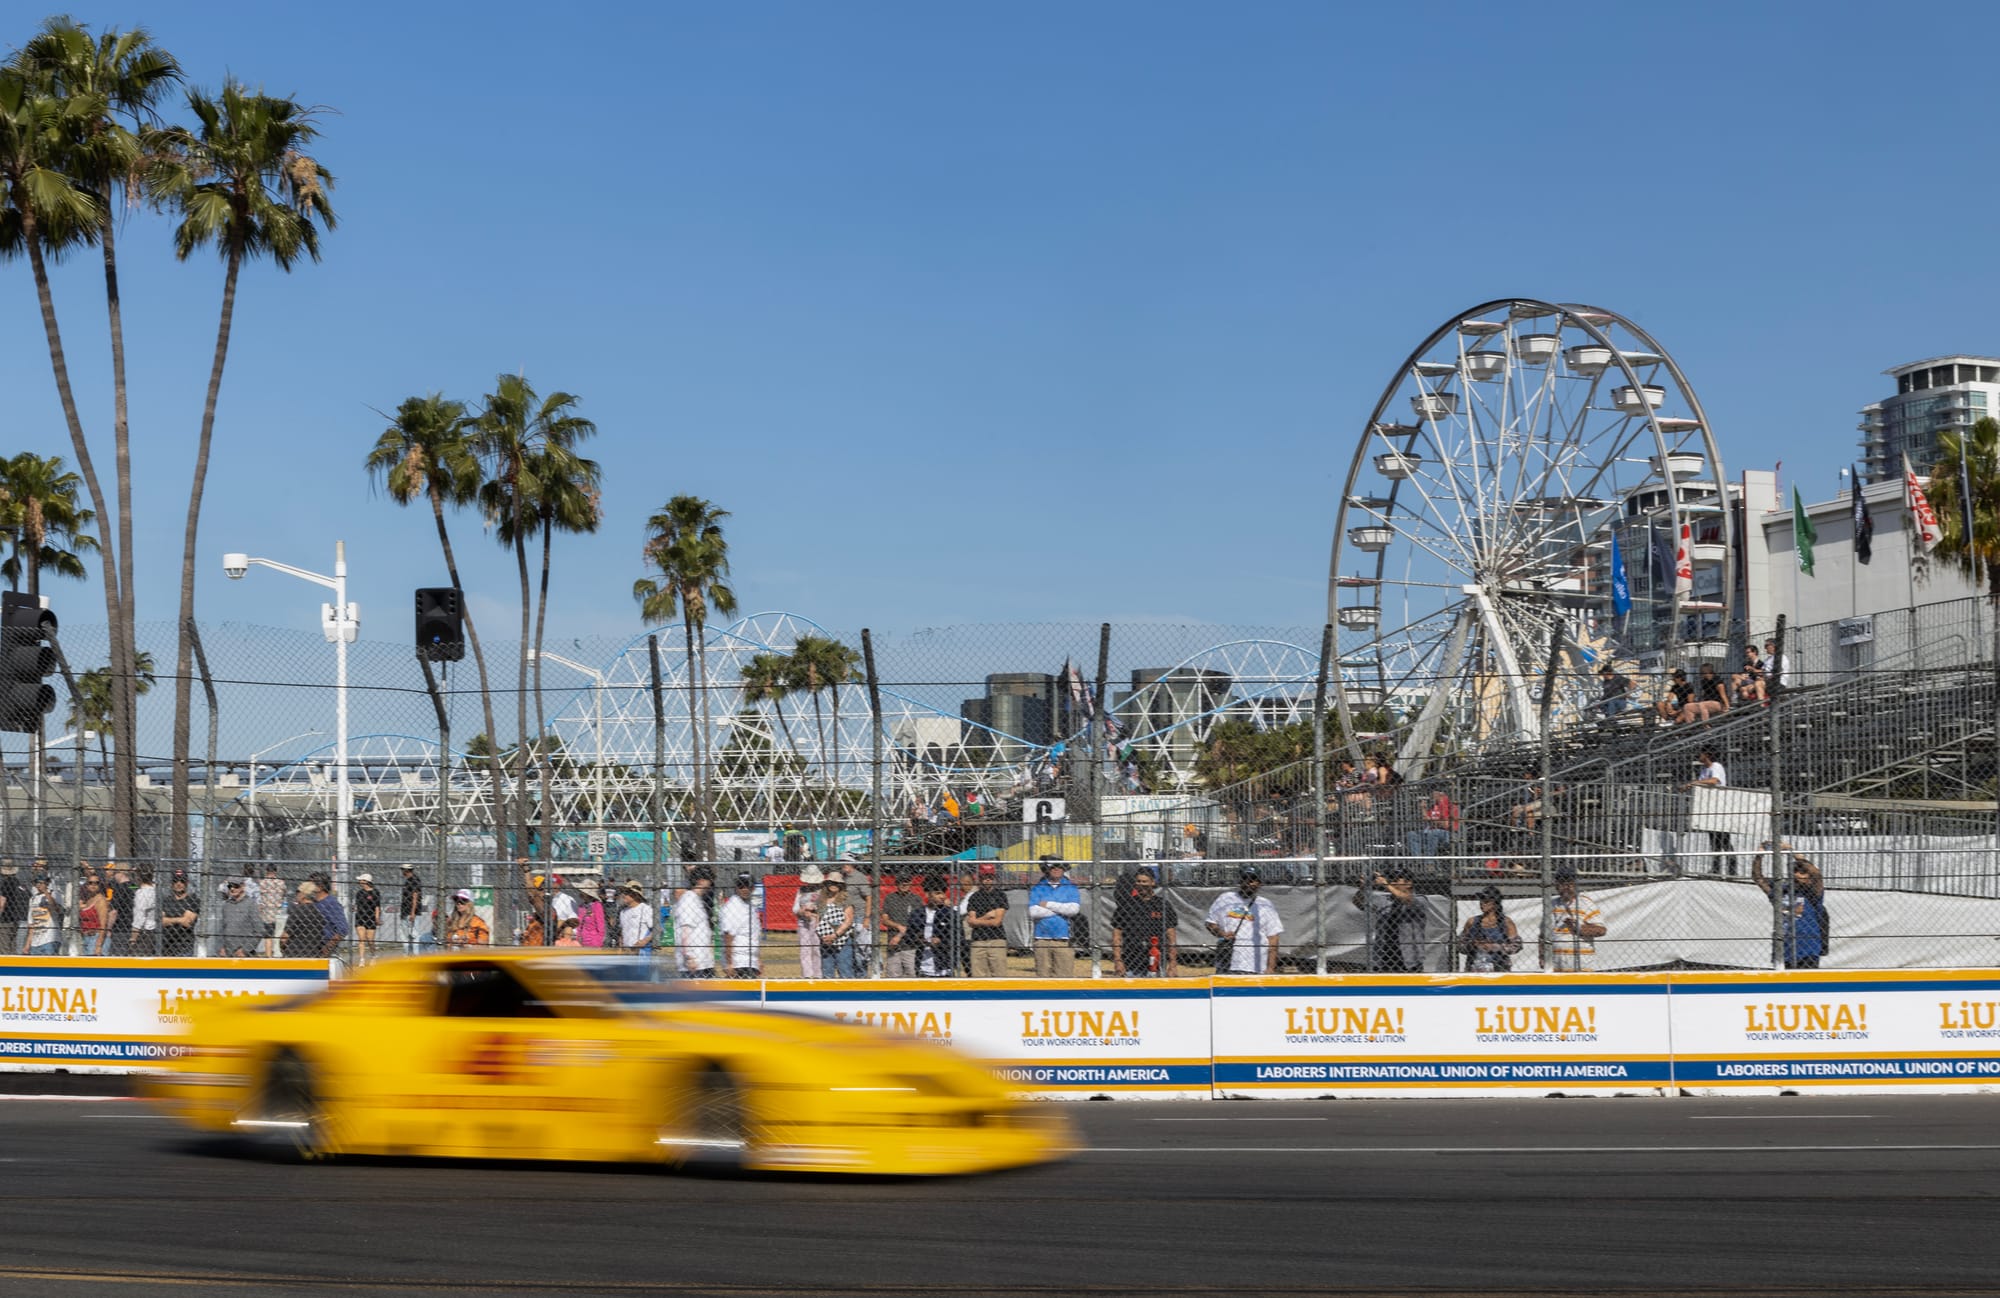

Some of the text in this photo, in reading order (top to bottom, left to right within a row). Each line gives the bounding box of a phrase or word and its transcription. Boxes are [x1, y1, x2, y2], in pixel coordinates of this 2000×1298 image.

[591, 843, 605, 853] 35
[2, 986, 97, 1014] LiUNA!
[2, 1012, 98, 1022] YOUR WORKFORCE SOLUTION
[158, 1016, 179, 1024] YOUR
[1285, 1007, 1404, 1034] LiUNA!
[1475, 1005, 1596, 1033] LiUNA!
[1744, 1003, 1866, 1031] LiUNA!
[1939, 1001, 2000, 1029] LiU
[1021, 1010, 1139, 1037] LiUNA!
[1286, 1035, 1406, 1043] YOUR WORKFORCE SOLUTION
[1502, 1034, 1553, 1042] WORKFORCE
[1556, 1034, 1597, 1042] SOLUTION
[1771, 1032, 1824, 1040] WORKFORCE
[1940, 1030, 1964, 1038] YOUR
[1100, 1038, 1140, 1046] SOLUTION
[34, 1043, 124, 1056] INTERNATIONAL
[126, 1045, 166, 1056] UNION
[169, 1046, 186, 1057] OF
[1035, 1069, 1055, 1081] OF
[1057, 1069, 1105, 1081] NORTH
[1107, 1069, 1170, 1080] AMERICA
[1256, 1066, 1628, 1078] LABORERS INTERNATIONAL UNION OF NORTH AMERICA
[1717, 1064, 1788, 1076] LABORERS
[1791, 1063, 1903, 1076] INTERNATIONAL
[1905, 1062, 1954, 1074] UNION
[1955, 1062, 1976, 1073] OF
